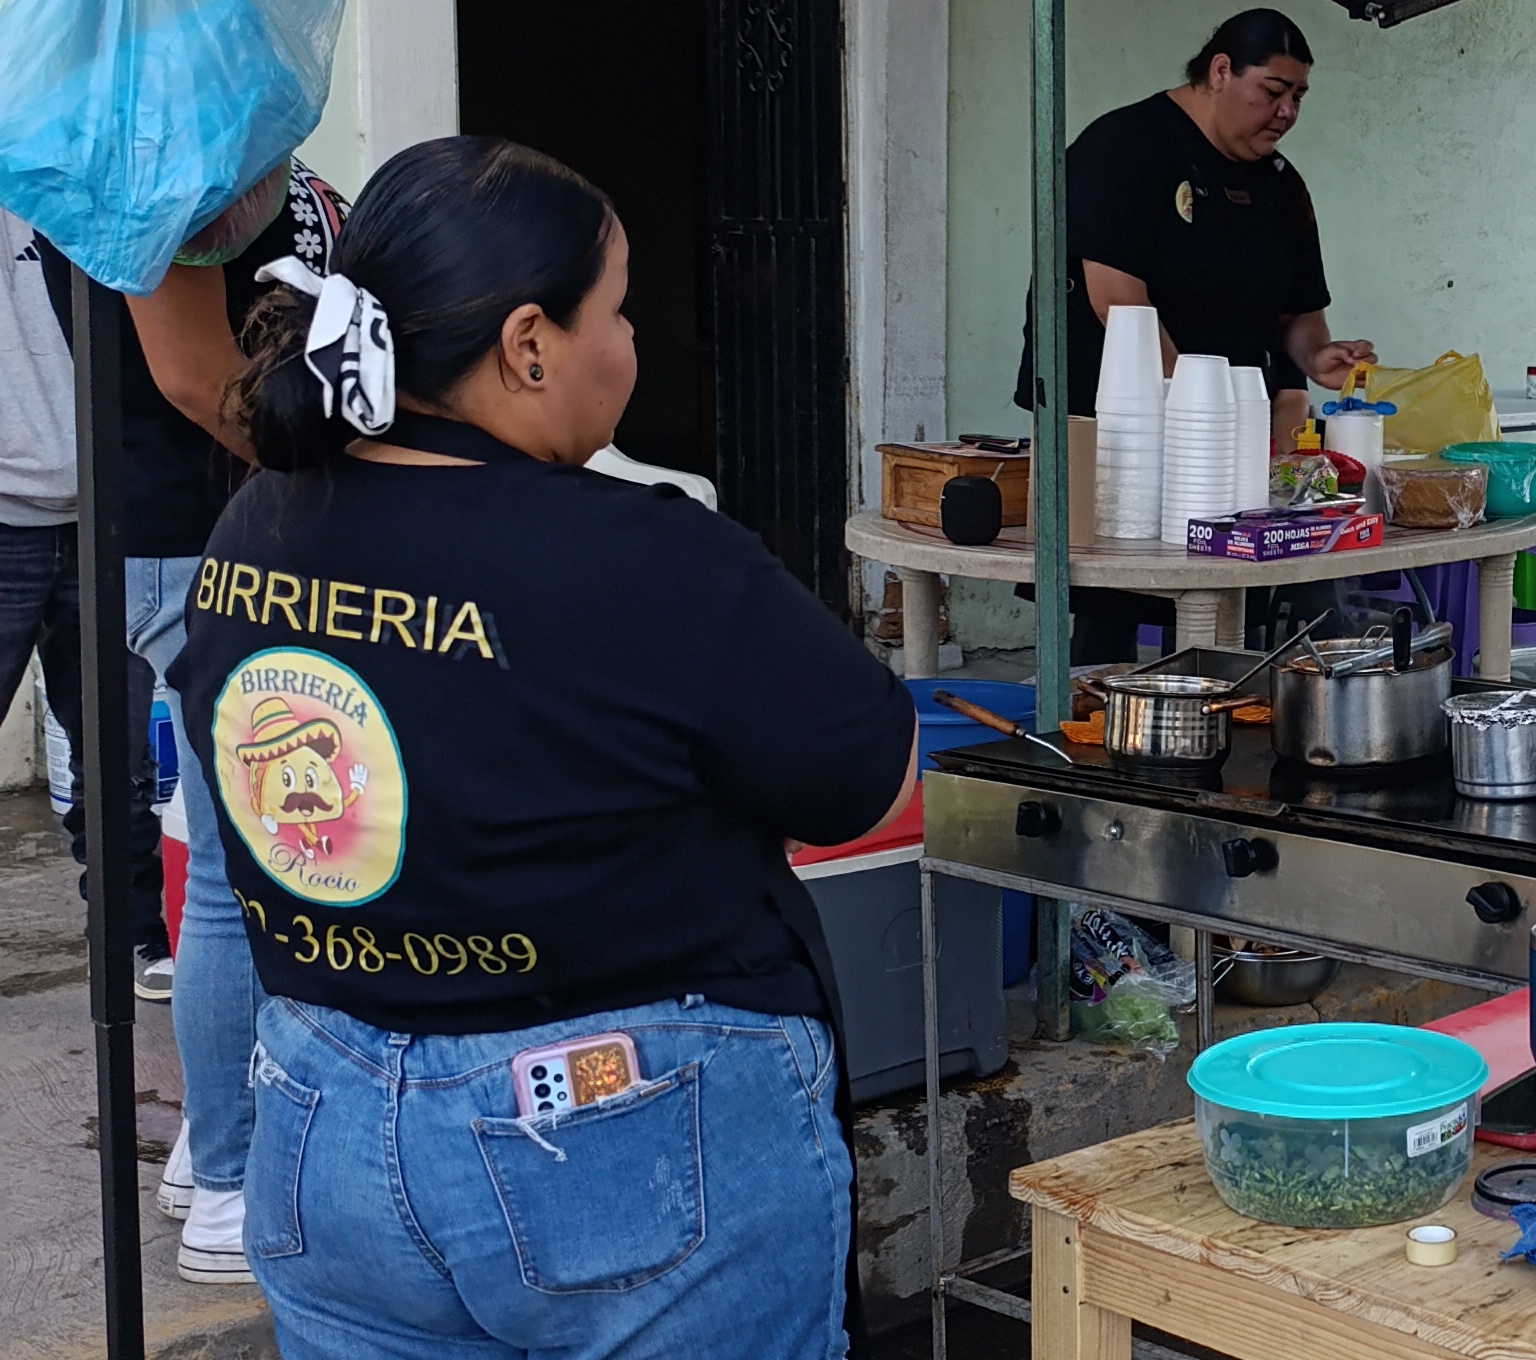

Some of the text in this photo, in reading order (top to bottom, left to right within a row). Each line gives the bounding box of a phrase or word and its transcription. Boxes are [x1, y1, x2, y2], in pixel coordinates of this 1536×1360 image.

[1189, 524, 1213, 540] 200
[1263, 529, 1284, 545] 200
[1284, 528, 1310, 541] HOJAS
[197, 557, 495, 659] BIRRIERIA
[240, 667, 369, 729] BIRRIERÍA
